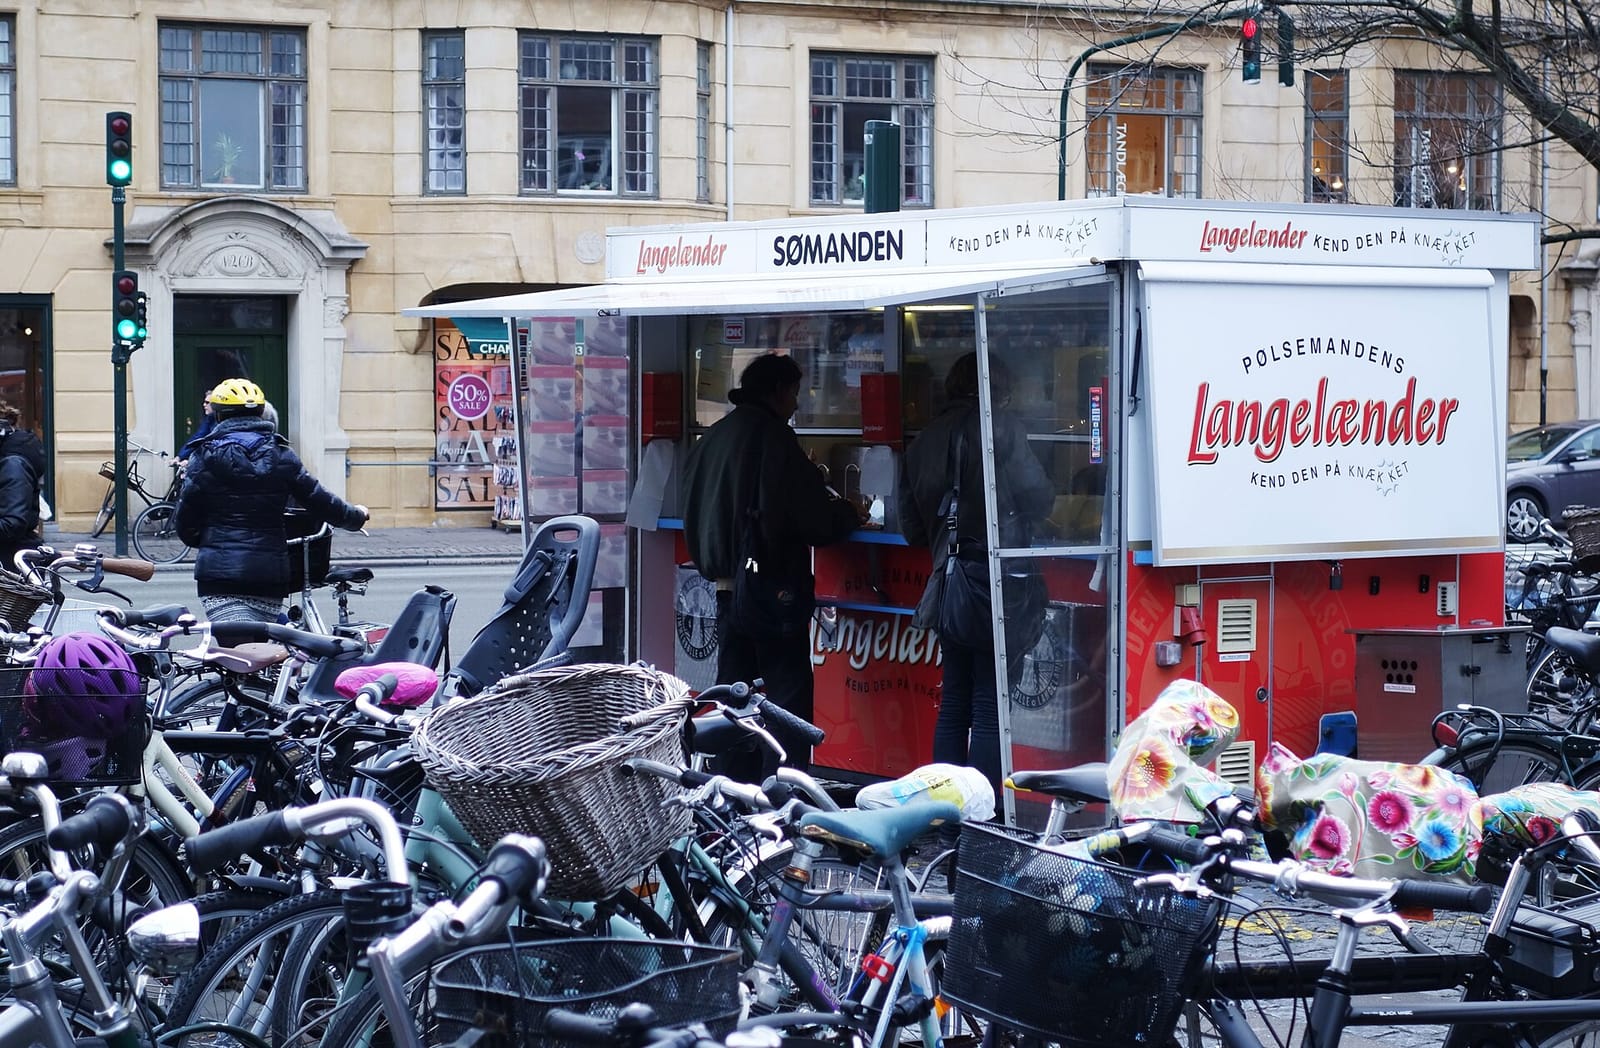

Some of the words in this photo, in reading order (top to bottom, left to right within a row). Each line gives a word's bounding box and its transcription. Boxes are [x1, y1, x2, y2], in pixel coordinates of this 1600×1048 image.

[1115, 122, 1127, 193] TANDLÆG
[773, 229, 904, 268] SØMANDEN
[949, 235, 981, 253] KEND
[986, 226, 1012, 248] DEN
[1016, 219, 1031, 239] PÅ
[1199, 220, 1308, 253] Langelænder
[1313, 235, 1350, 252] KEND
[1355, 234, 1384, 250] DEN
[1390, 225, 1406, 245] PÅ
[636, 234, 727, 275] Langelænder
[725, 326, 743, 337] DK
[437, 333, 510, 362] SA
[1242, 337, 1405, 374] PØLSEMANDENS
[453, 384, 487, 402] 50%
[459, 401, 481, 410] SALE
[1187, 376, 1459, 465] Langelænder
[1250, 471, 1286, 488] KEND
[1291, 466, 1319, 485] DEN
[1325, 459, 1341, 477] PÅ
[845, 676, 870, 693] KEND
[873, 679, 893, 693] DEN
